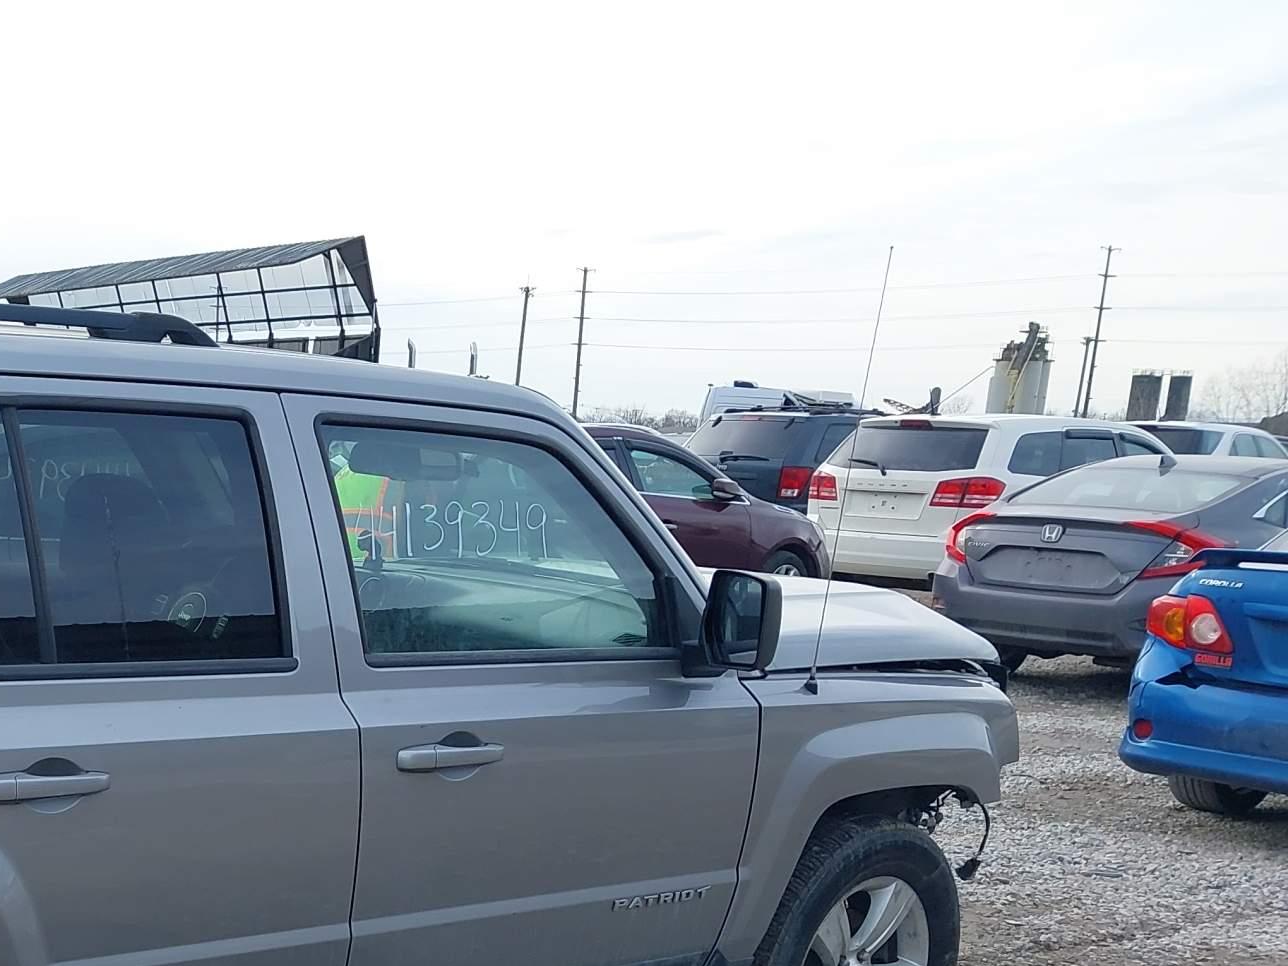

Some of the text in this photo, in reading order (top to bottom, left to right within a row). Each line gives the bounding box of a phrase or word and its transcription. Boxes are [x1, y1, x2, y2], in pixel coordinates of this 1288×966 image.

[355, 499, 548, 560] 44139349
[1199, 578, 1245, 589] COROLLA
[611, 884, 712, 911] PATRIOT
